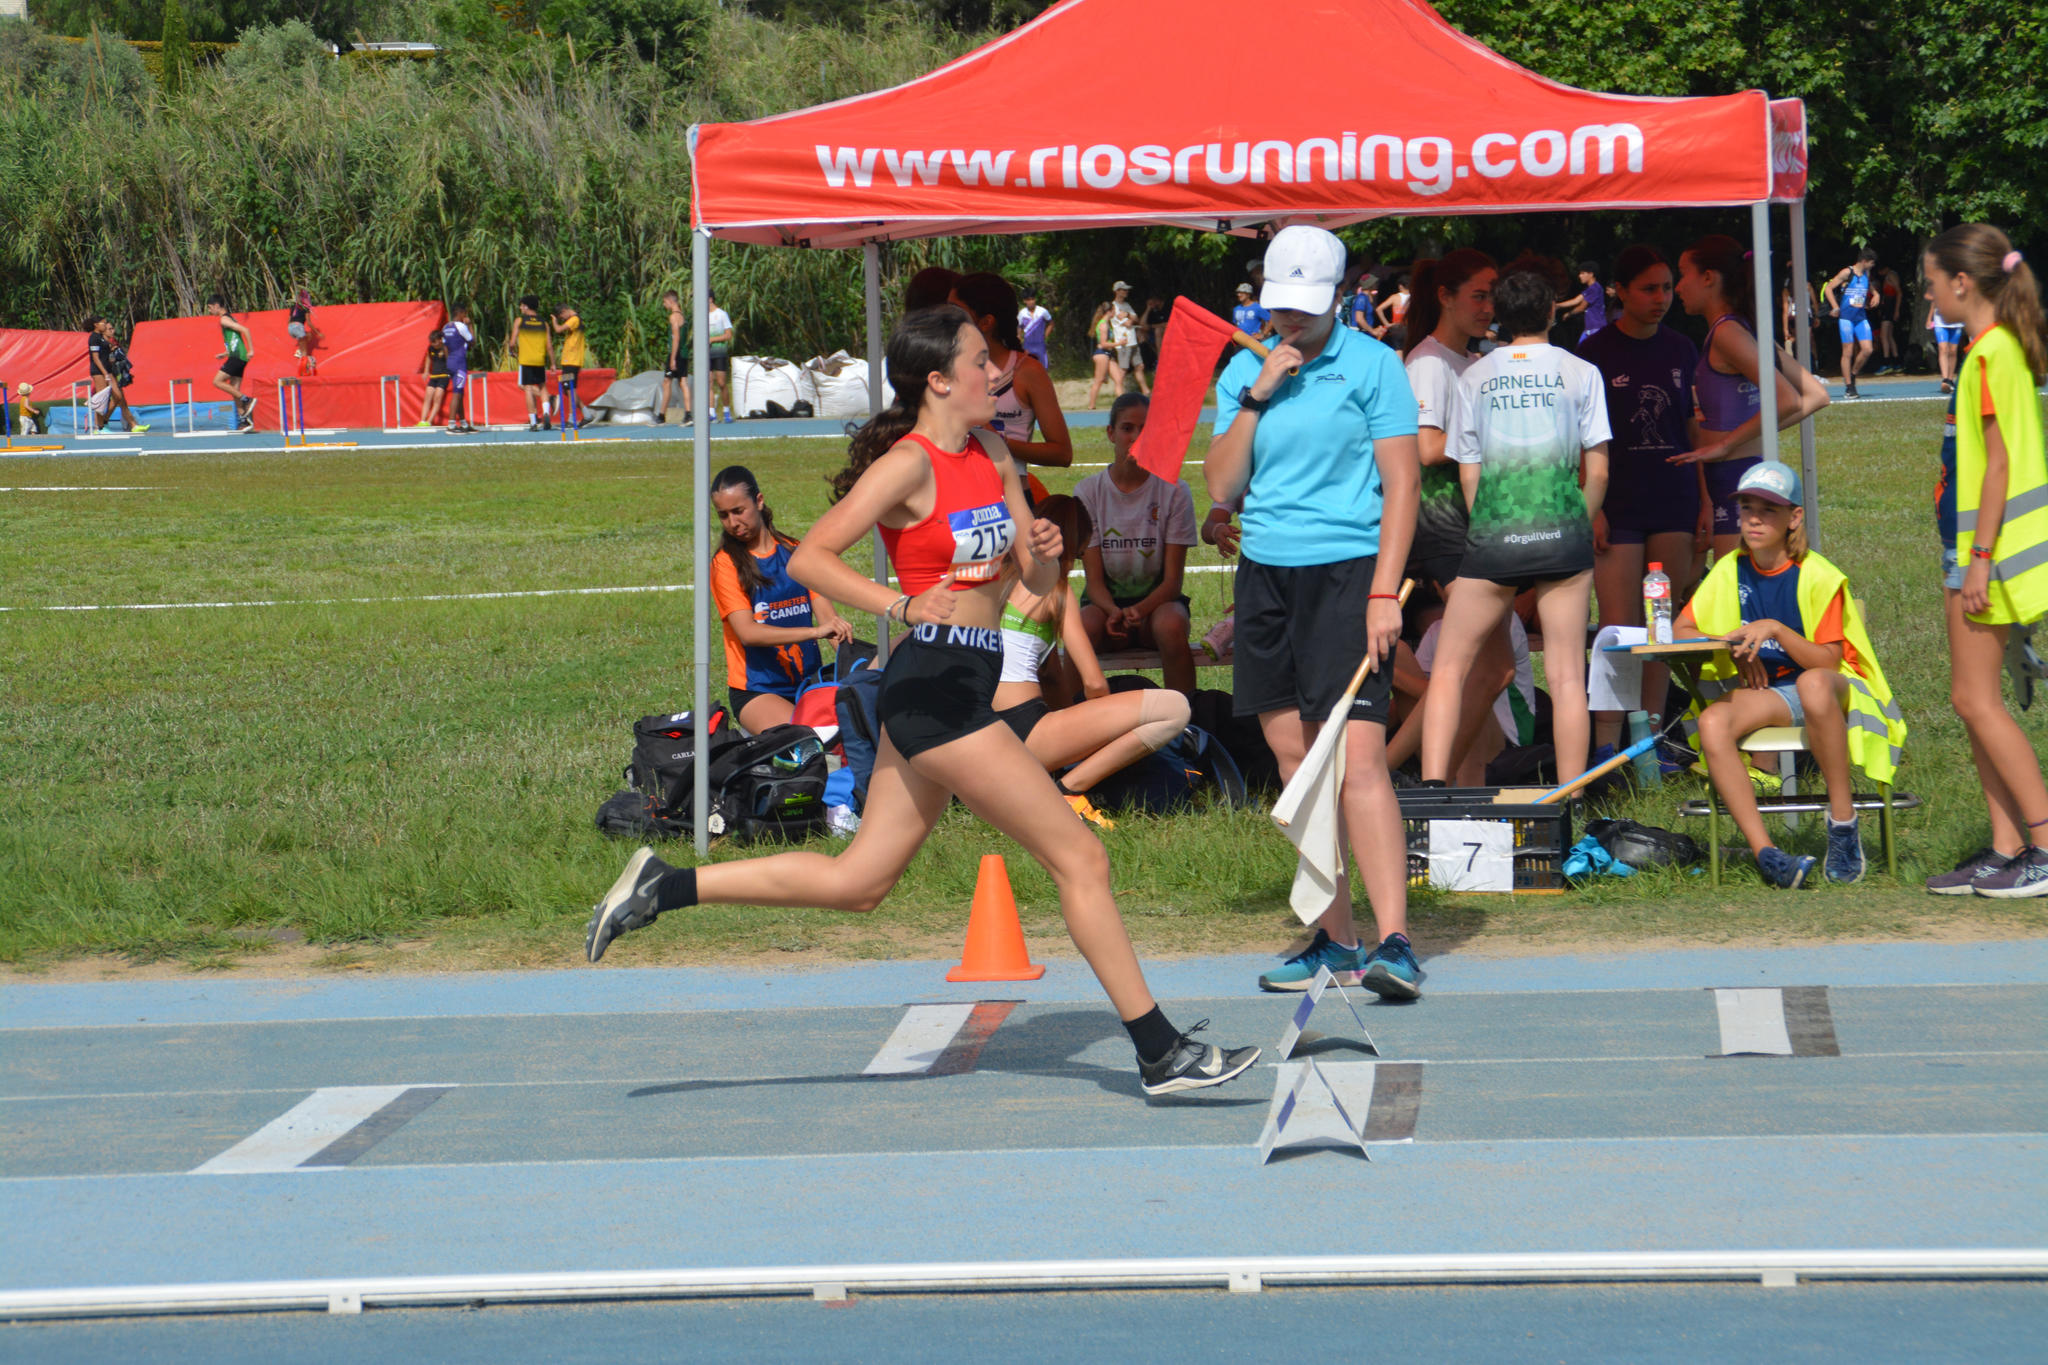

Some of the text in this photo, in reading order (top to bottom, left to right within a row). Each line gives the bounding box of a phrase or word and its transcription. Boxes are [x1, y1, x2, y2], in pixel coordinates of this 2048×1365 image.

[1480, 371, 1565, 395] CORNELLÀ
[1490, 390, 1556, 410] ATLÈTIC
[971, 523, 1008, 560] 275
[1503, 530, 1562, 545] #OrgullVerd
[1463, 842, 1483, 872] 7
